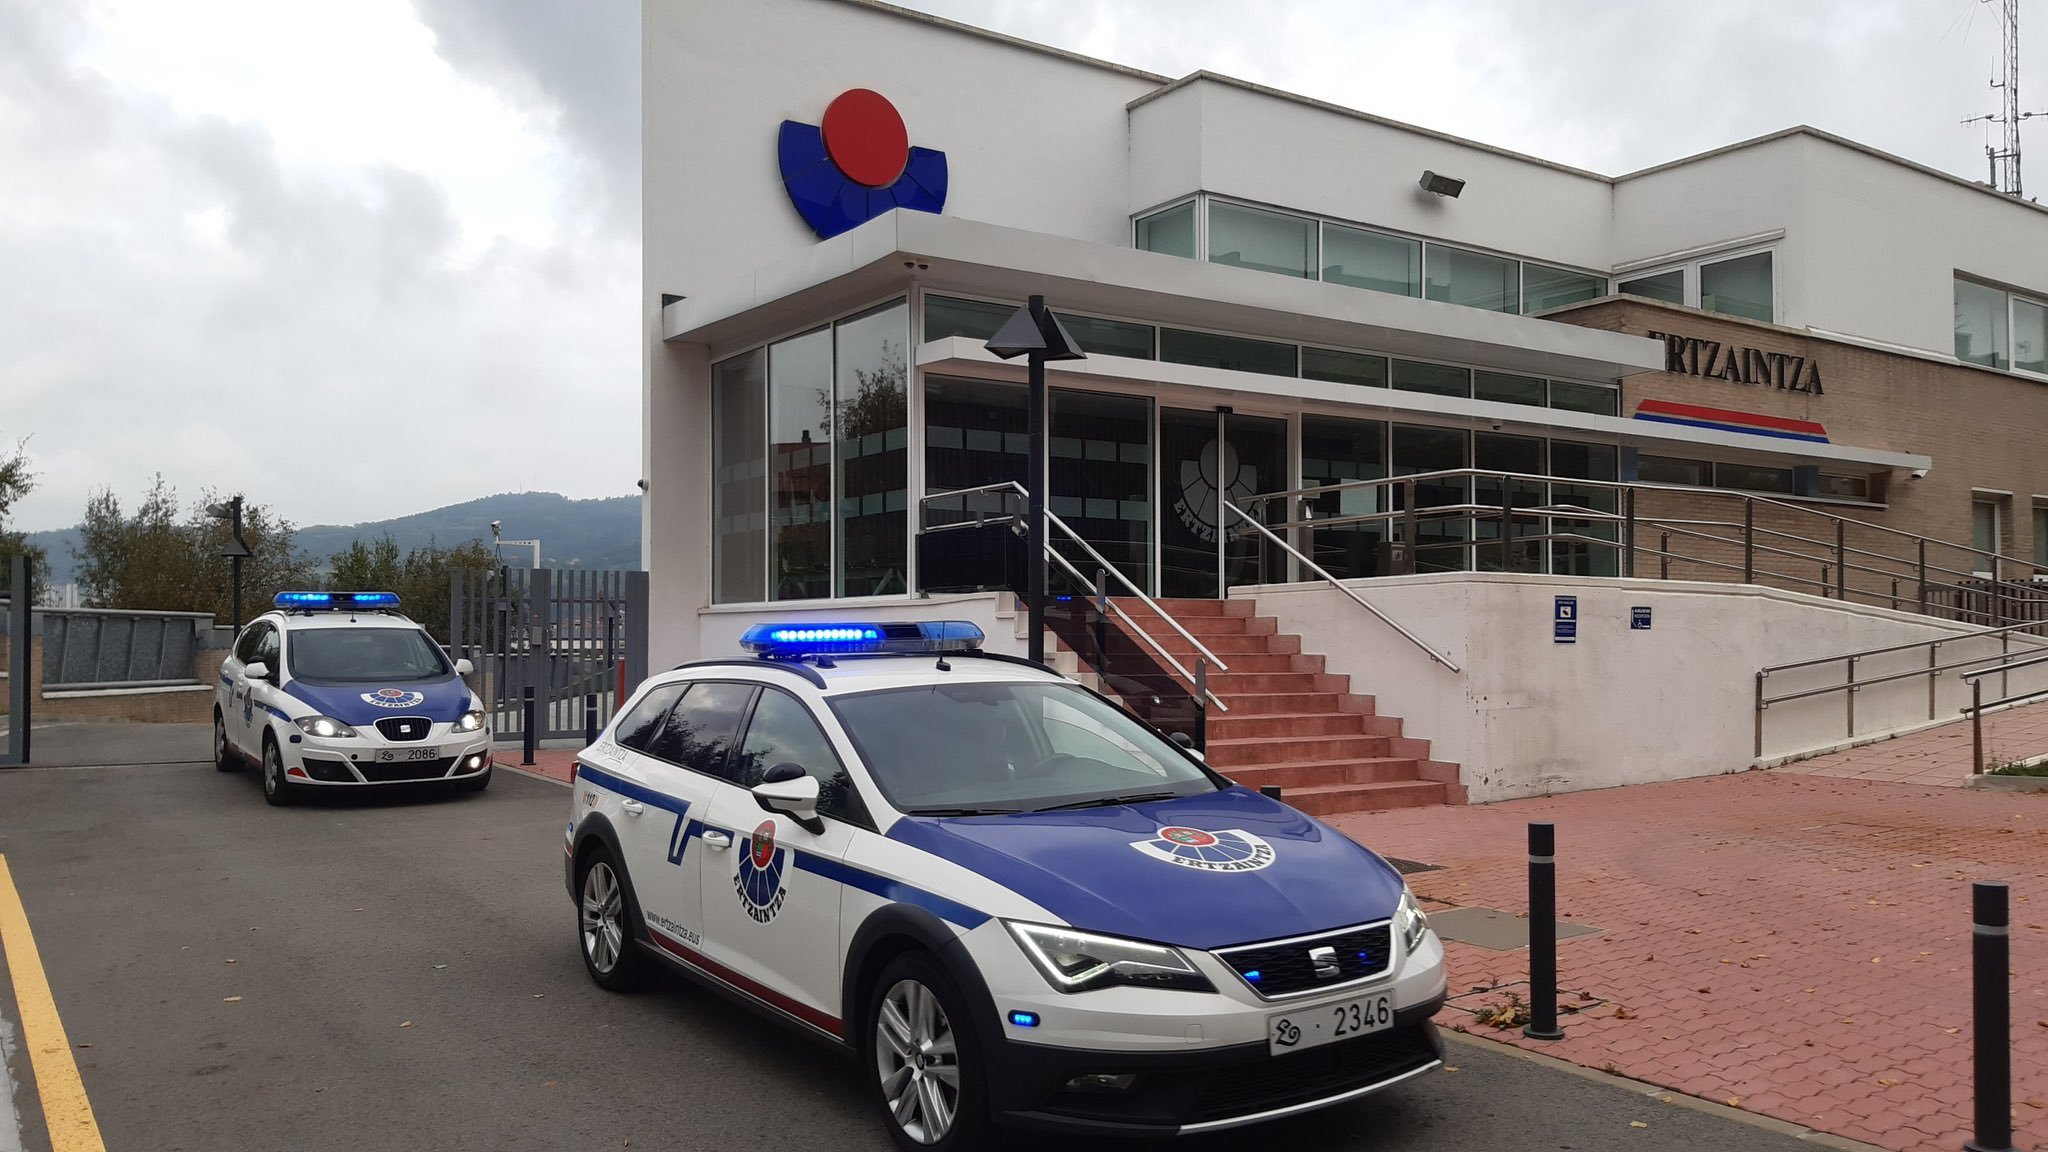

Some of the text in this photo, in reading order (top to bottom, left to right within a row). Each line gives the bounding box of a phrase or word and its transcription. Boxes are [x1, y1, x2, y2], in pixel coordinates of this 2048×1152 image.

[1648, 330, 1825, 395] RTZAINTZA
[408, 749, 436, 760] 2086
[1171, 844, 1272, 871] ERTZAINTZA
[733, 872, 787, 923] ERTZAINTZA
[646, 910, 701, 946] www.ertzaintza.eus
[1334, 997, 1389, 1036] 2346
